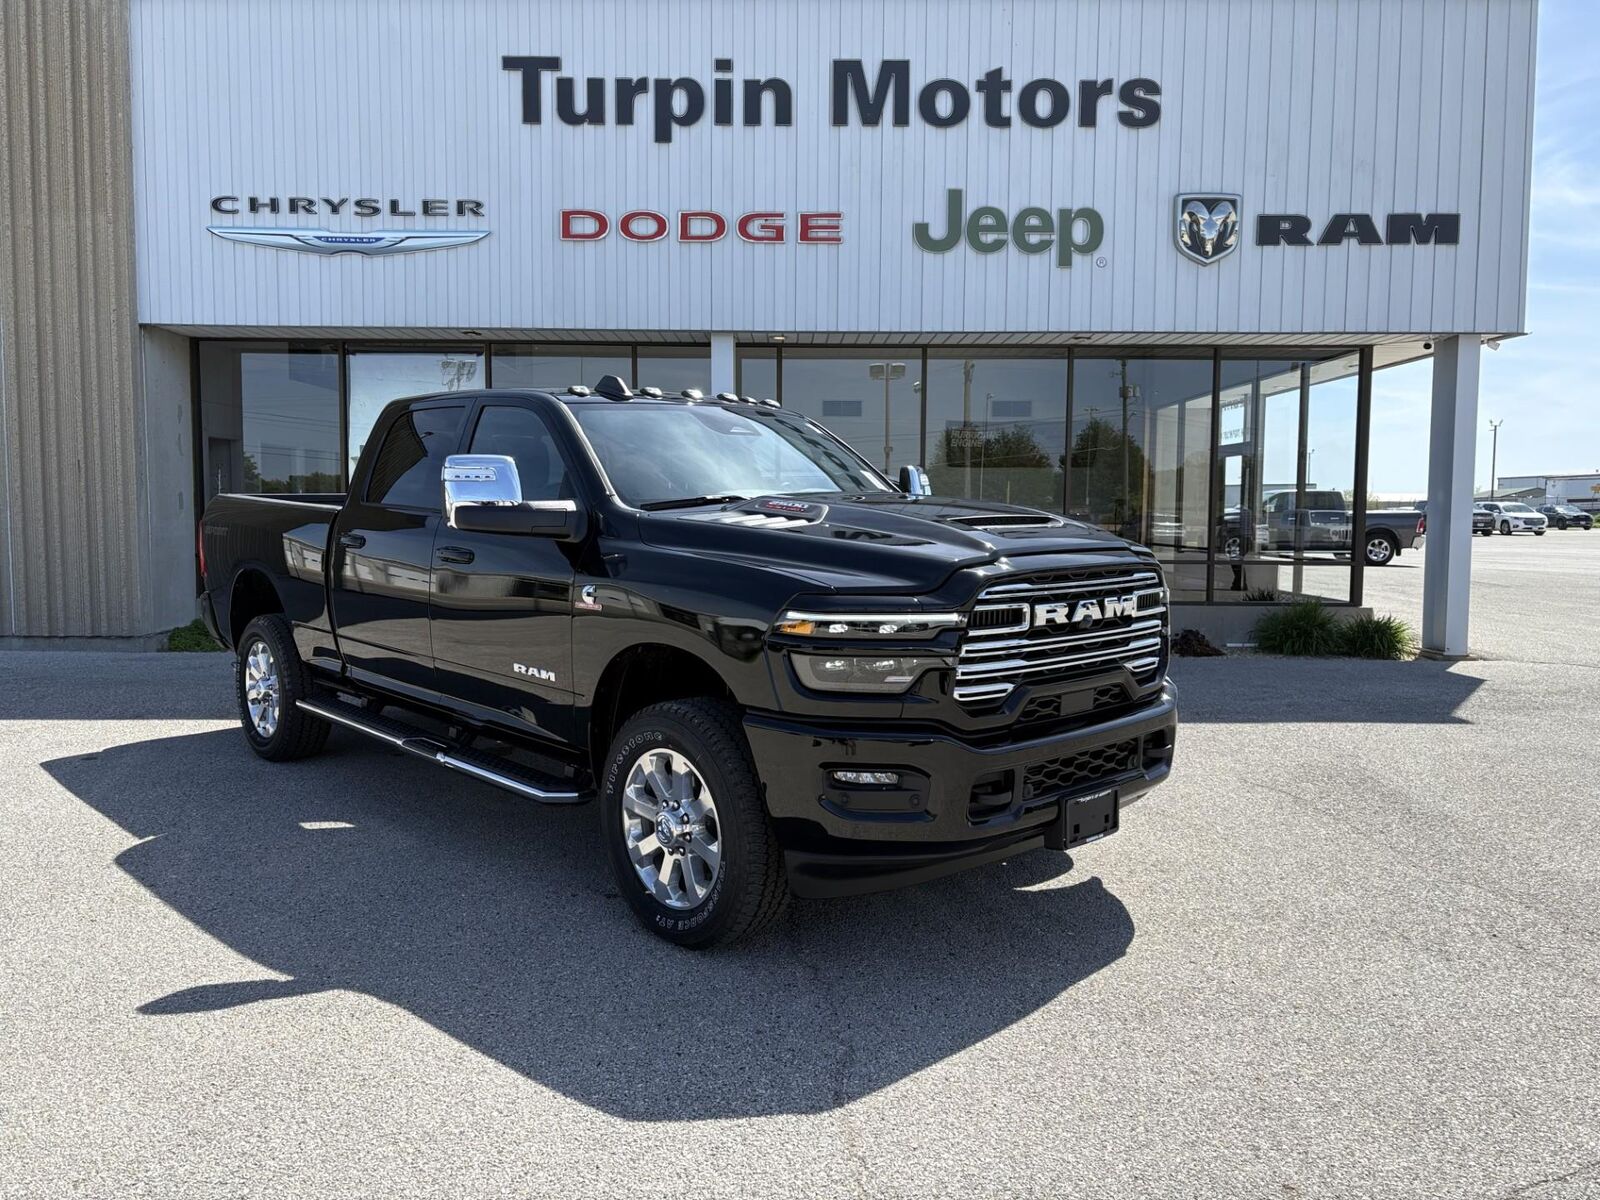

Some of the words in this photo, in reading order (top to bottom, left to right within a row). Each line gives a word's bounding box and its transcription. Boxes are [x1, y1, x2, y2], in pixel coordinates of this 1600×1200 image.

[501, 55, 793, 143] Turpin
[831, 58, 1162, 129] Motors
[210, 195, 485, 218] CHRYSLER
[559, 208, 844, 245] DODGE
[911, 187, 1105, 269] Jeep
[1255, 212, 1461, 246] RAM
[951, 438, 983, 448] ENGINE
[1033, 595, 1136, 627] RAM
[513, 662, 556, 683] RAM
